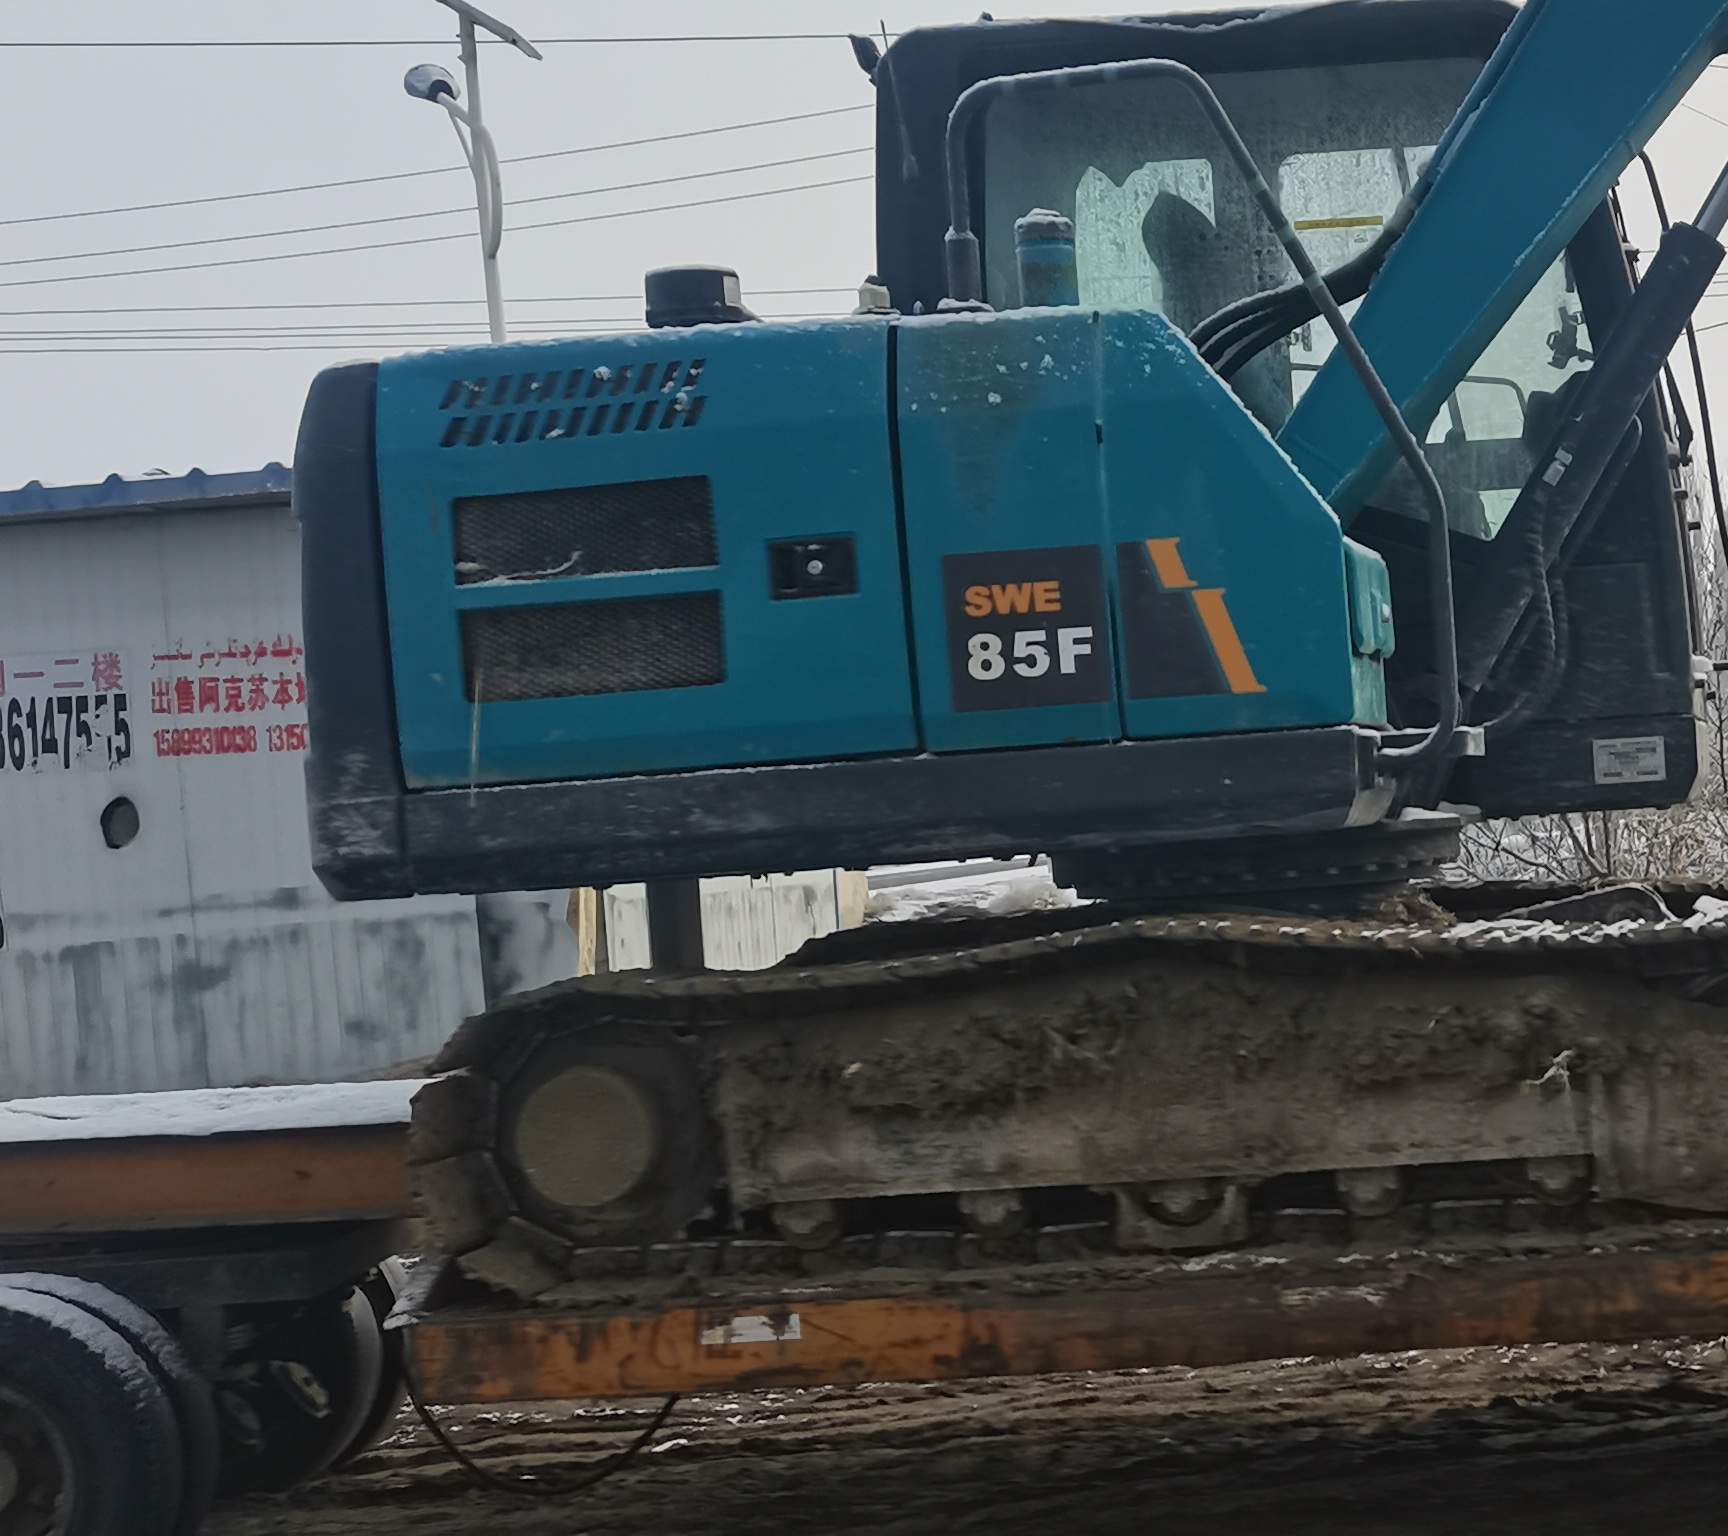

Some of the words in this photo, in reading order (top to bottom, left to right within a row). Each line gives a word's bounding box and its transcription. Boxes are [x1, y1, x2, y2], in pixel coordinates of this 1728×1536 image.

[963, 580, 1062, 618] SWE
[0, 652, 123, 698] 一二楼
[967, 626, 1094, 681] 85F
